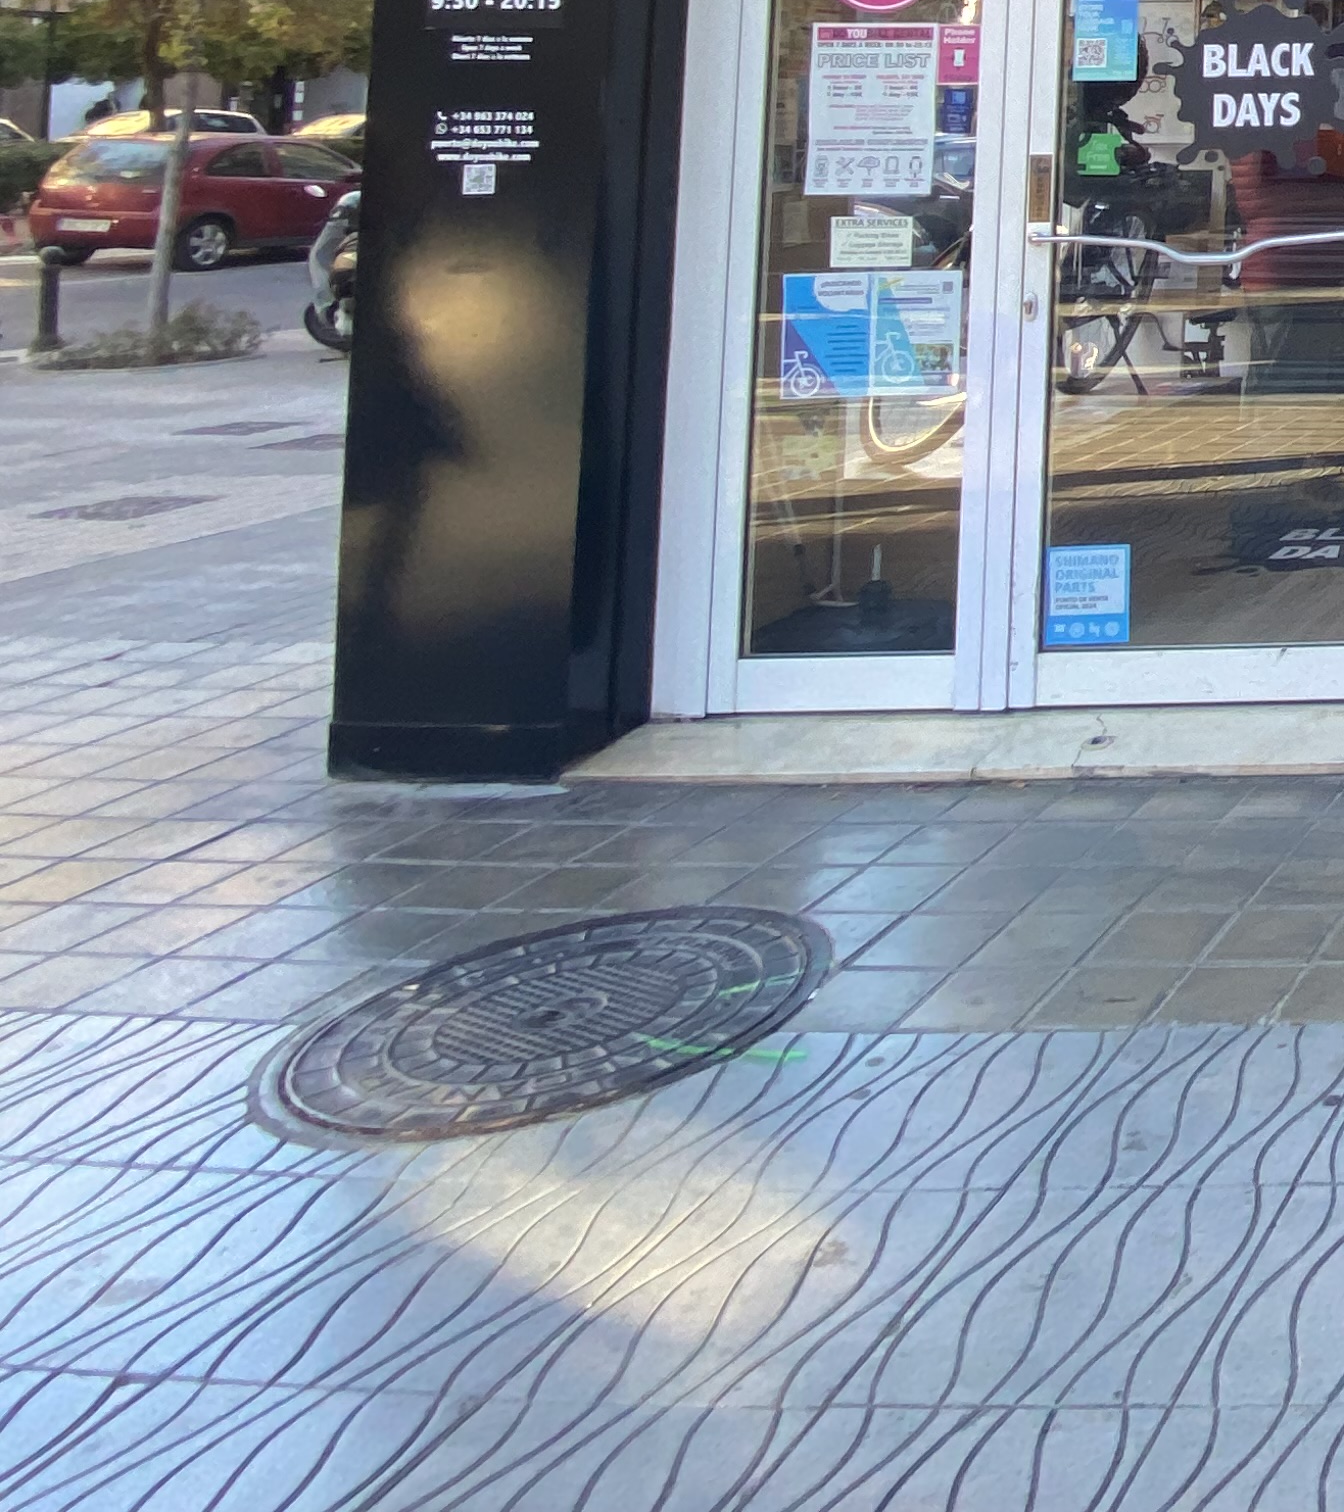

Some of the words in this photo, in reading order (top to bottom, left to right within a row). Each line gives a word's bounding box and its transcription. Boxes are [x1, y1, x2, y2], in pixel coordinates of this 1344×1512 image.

[818, 53, 880, 69] PRICE
[884, 53, 931, 69] LIST
[1202, 42, 1314, 78] BLACK
[1212, 93, 1301, 128] DAYS
[835, 219, 864, 228] EXTRA
[866, 219, 909, 228] SERVICES
[1056, 554, 1119, 567] SHIMANO
[1056, 568, 1119, 581] ORIGINAL
[1056, 581, 1096, 593] PARTS
